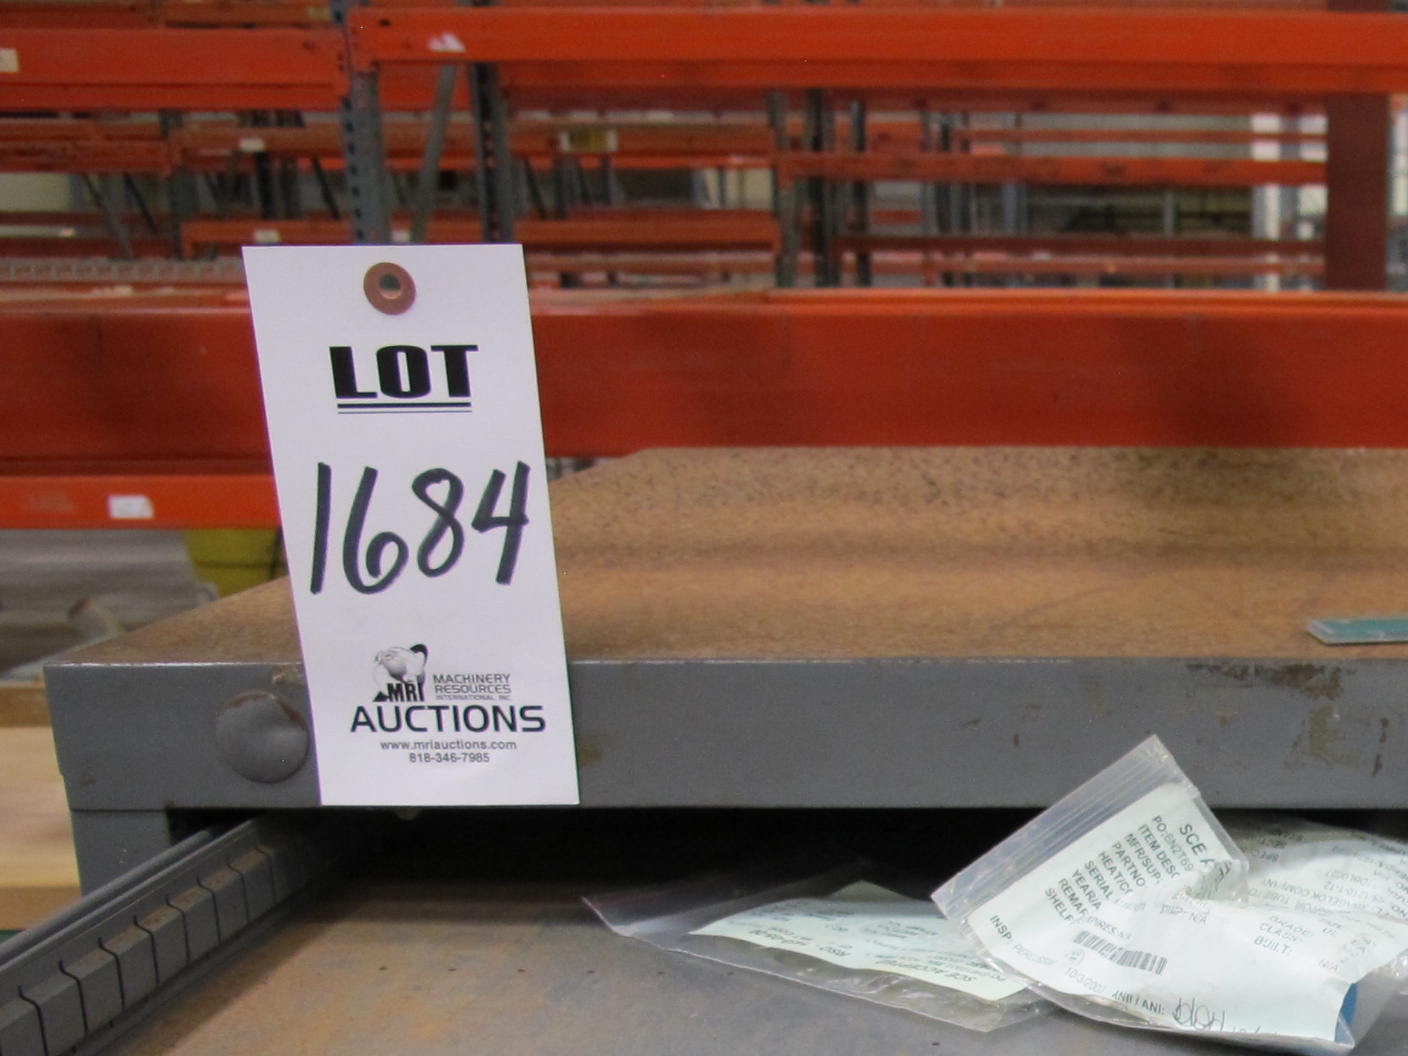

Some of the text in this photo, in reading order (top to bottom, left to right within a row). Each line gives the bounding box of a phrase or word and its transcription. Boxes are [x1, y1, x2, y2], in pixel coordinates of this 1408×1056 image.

[329, 345, 478, 399] LOT
[310, 460, 530, 595] 1684
[432, 673, 511, 684] MACHINERY
[387, 683, 425, 702] MRI
[434, 684, 512, 694] RESOURCES
[350, 705, 546, 733] AUCTIONS
[380, 740, 517, 750] www.mriauctions.com
[410, 753, 490, 763] 818-346-7985
[1179, 823, 1207, 856] SCE
